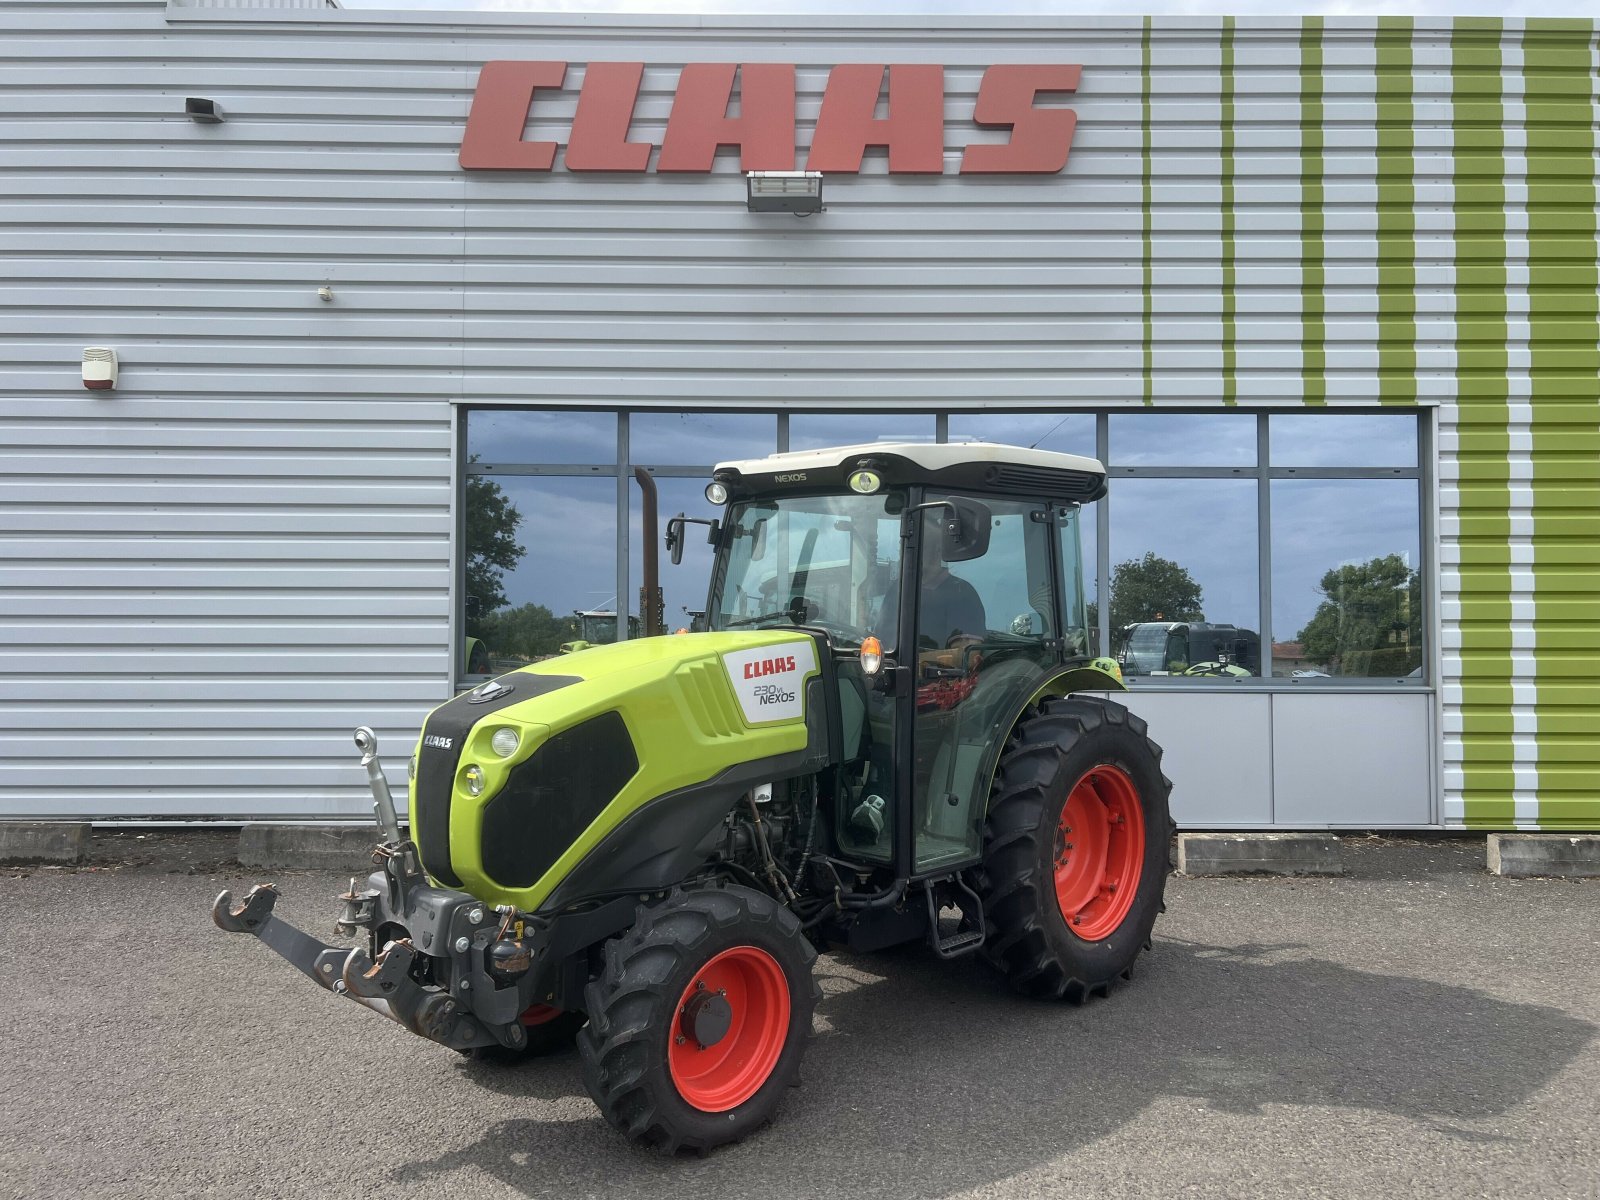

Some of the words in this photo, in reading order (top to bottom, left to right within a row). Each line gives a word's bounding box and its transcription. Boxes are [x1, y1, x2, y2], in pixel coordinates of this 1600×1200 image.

[459, 60, 1083, 174] CLAAS
[774, 473, 807, 483] NEXOS
[744, 656, 796, 679] CLAAS
[759, 692, 795, 705] NEXOS
[424, 735, 453, 750] CLAAS
